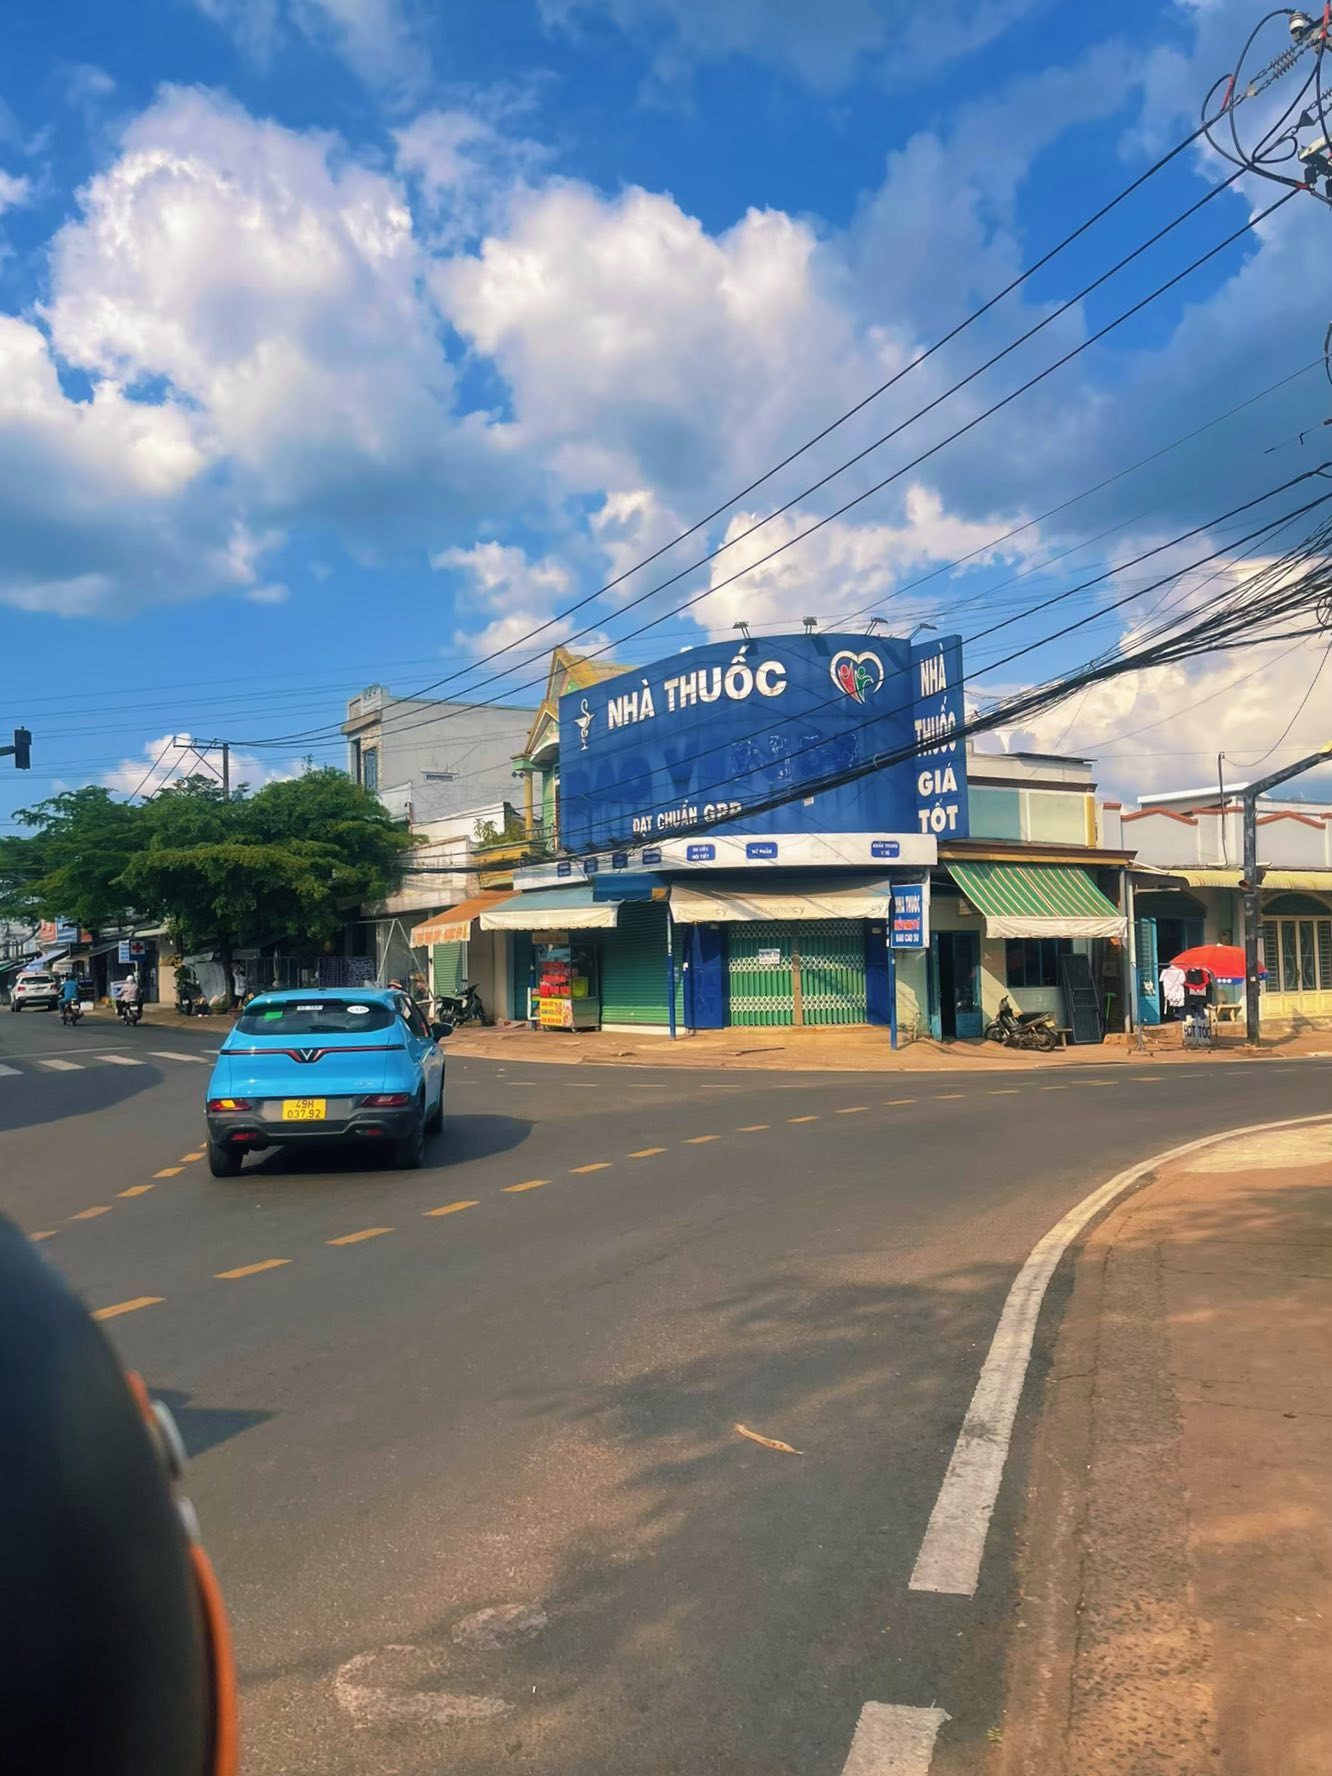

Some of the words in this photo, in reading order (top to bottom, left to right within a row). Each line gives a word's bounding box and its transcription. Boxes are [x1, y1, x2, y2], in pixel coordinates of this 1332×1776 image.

[608, 679, 655, 730] NHÀ
[664, 645, 787, 712] THUỐC
[920, 642, 947, 697] NHÀ
[918, 762, 958, 797] GIÁ
[632, 815, 653, 838] ĐẠT
[657, 799, 698, 830] CHUẨN
[918, 798, 959, 834] TỐT
